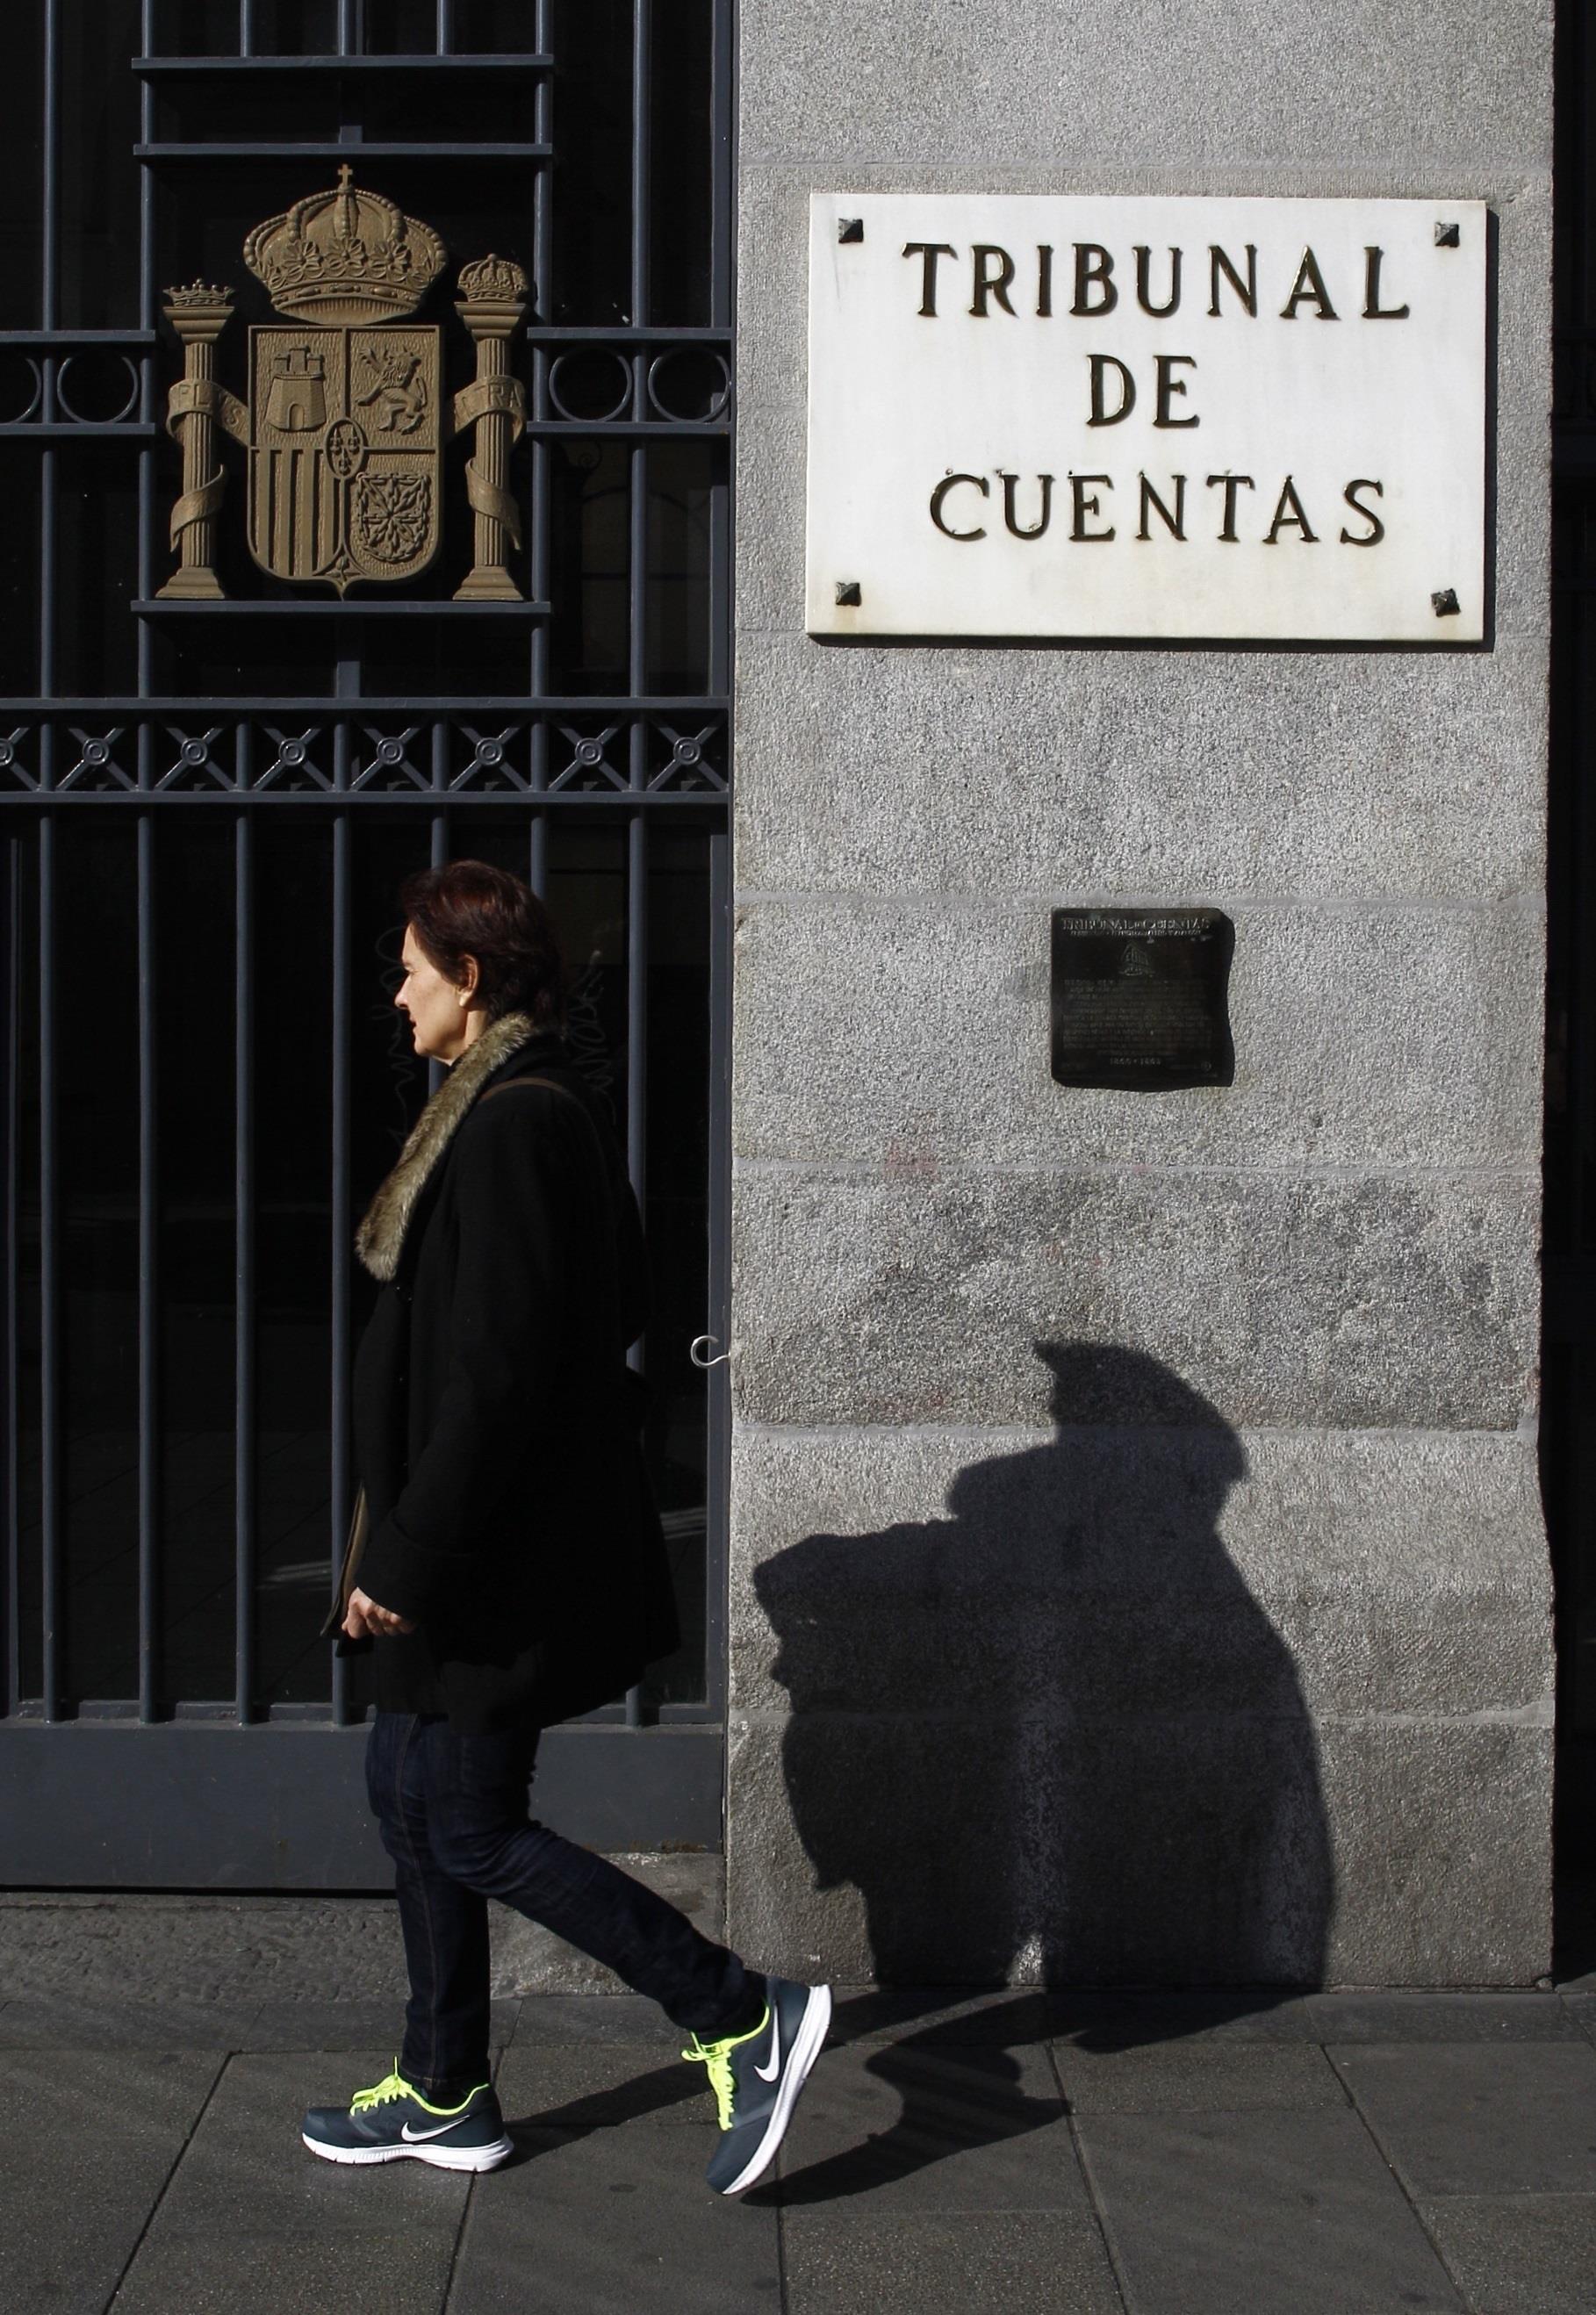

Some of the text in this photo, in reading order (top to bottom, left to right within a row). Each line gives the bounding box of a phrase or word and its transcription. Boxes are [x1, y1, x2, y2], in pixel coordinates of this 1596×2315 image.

[902, 242, 1410, 320] TRIBUNAL
[1086, 354, 1200, 429] DE
[930, 472, 1384, 547] CUENTAS
